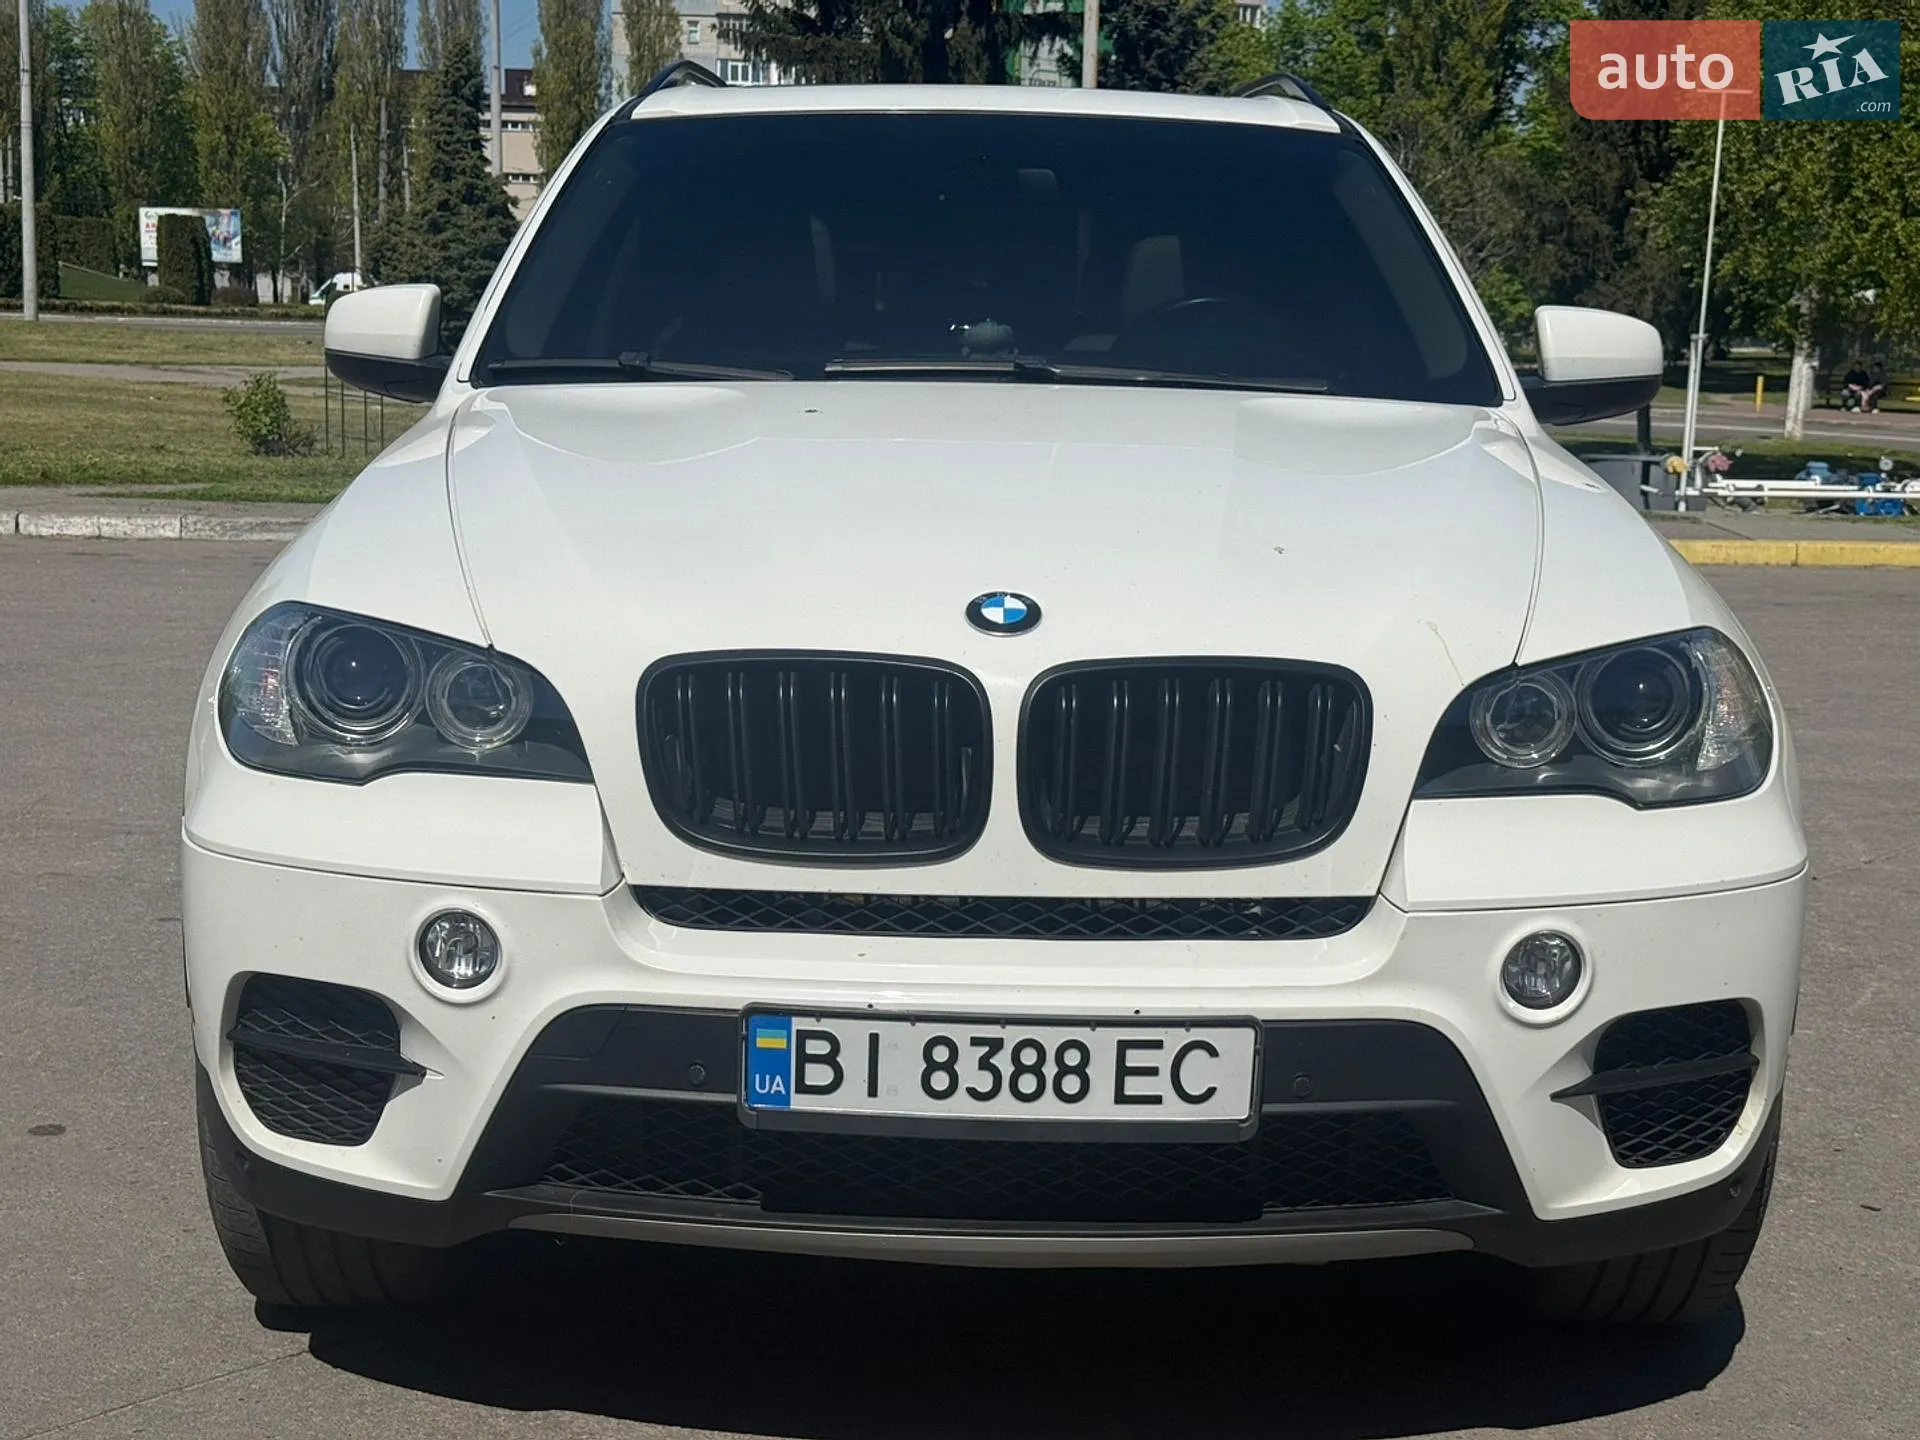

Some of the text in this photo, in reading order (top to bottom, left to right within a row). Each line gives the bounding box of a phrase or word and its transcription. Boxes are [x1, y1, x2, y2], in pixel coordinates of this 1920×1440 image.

[755, 1075, 786, 1095] UA
[795, 1029, 1220, 1105] BI 8388 EC
